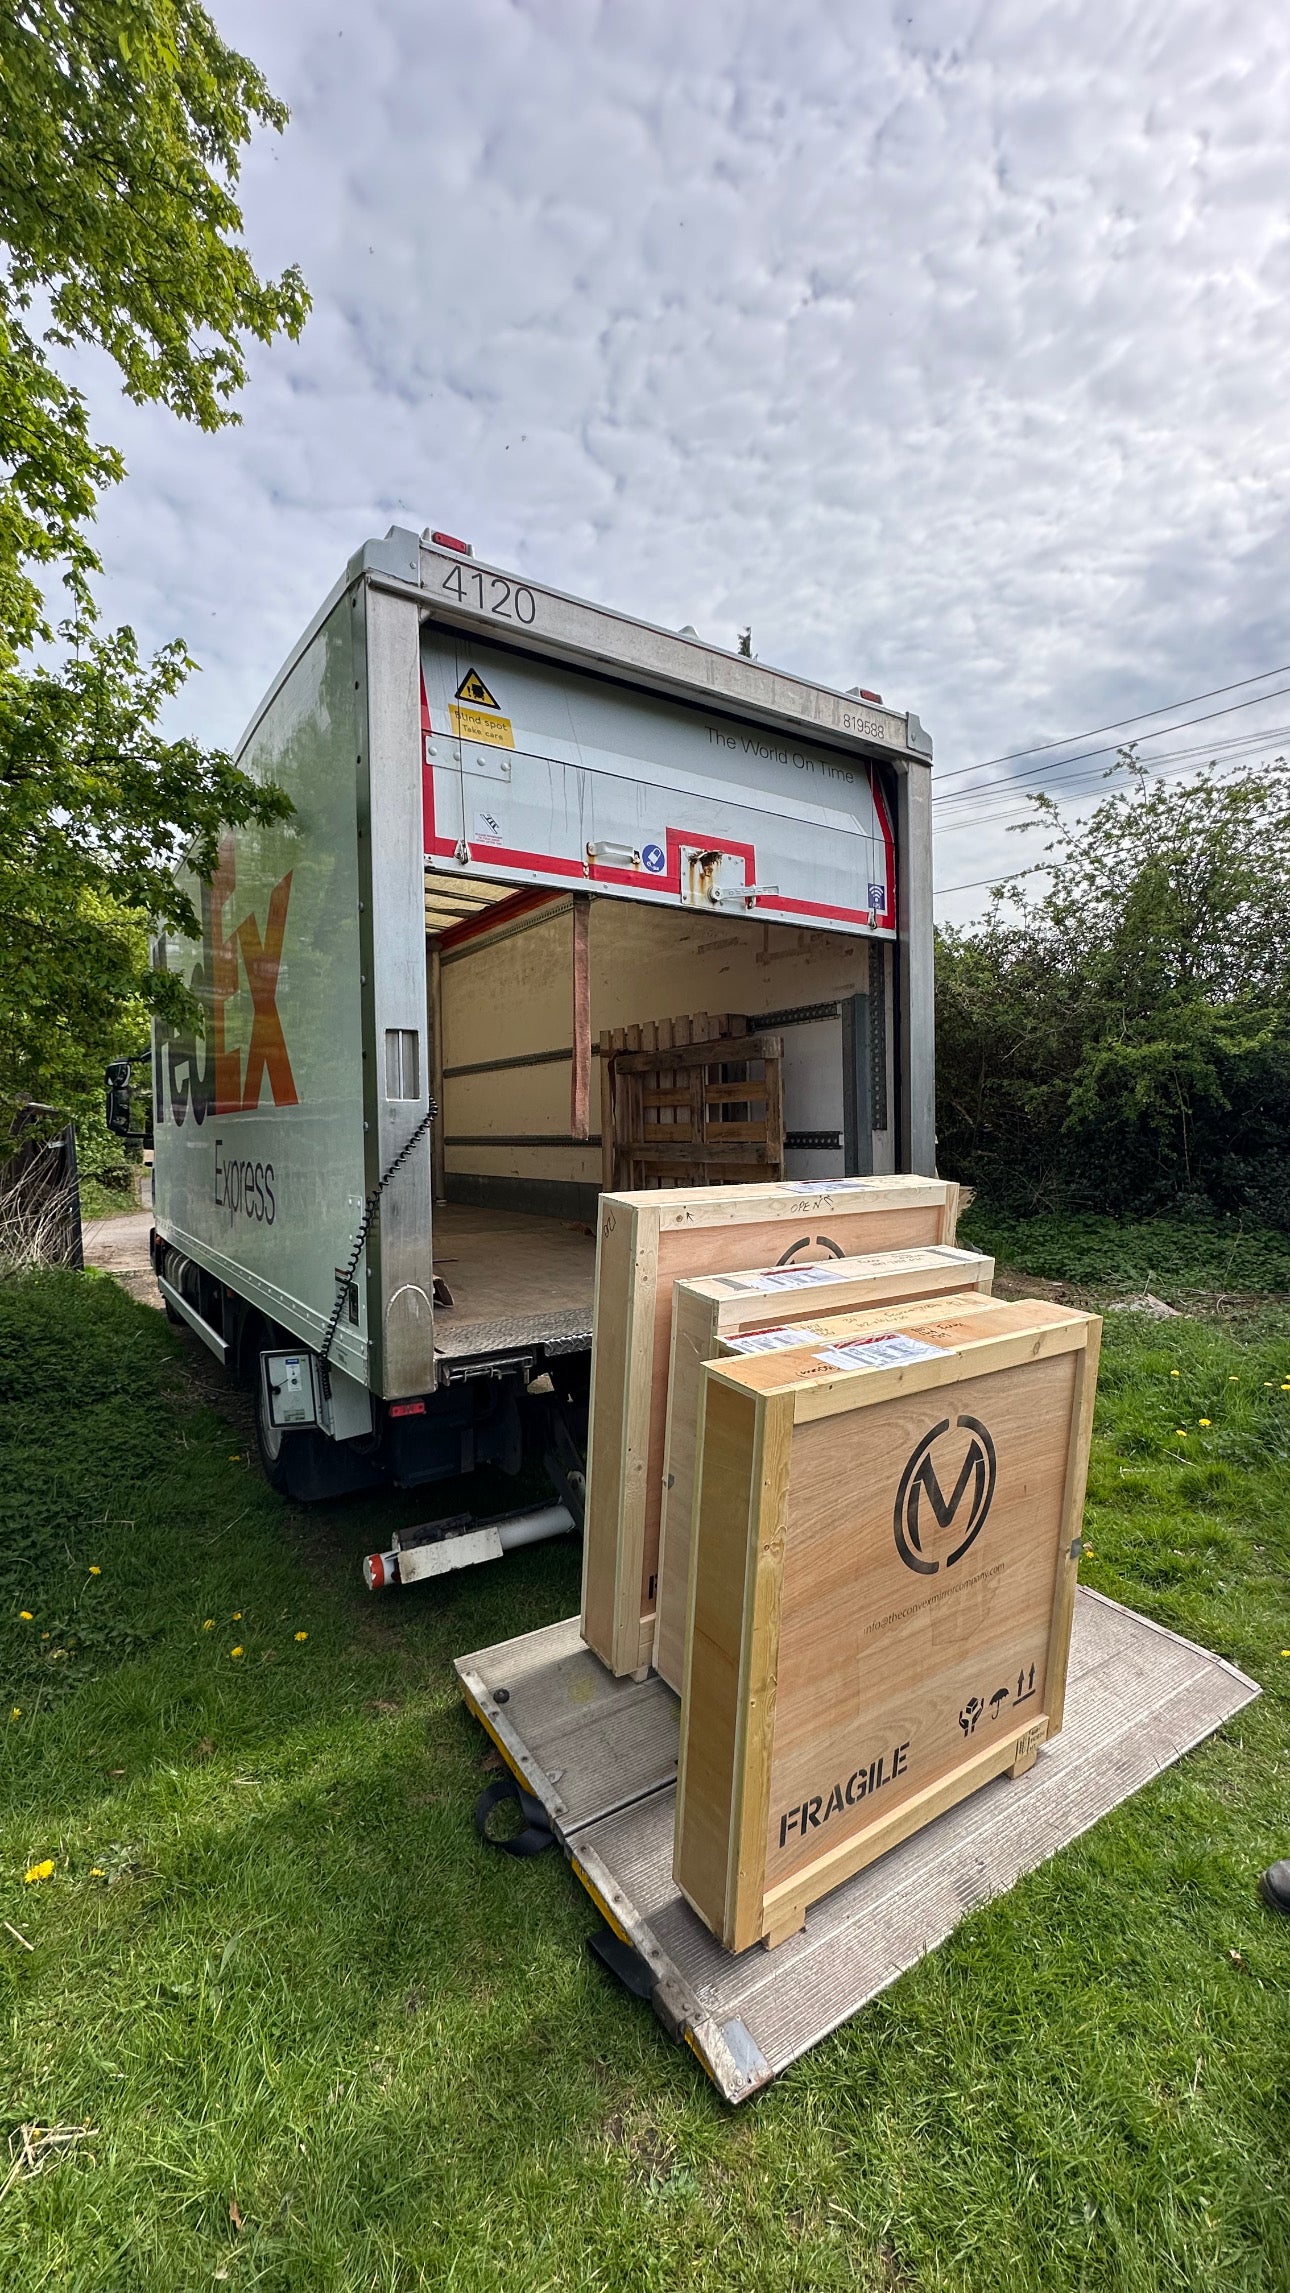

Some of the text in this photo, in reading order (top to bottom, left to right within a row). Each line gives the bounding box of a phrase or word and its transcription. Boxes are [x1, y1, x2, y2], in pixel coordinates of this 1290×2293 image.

[442, 564, 536, 624] 4120
[455, 710, 508, 732] Blind spot
[462, 724, 504, 741] Take care
[843, 713, 885, 739] 819588
[704, 726, 855, 785] The World On Time
[215, 1139, 275, 1228] Express
[790, 1196, 823, 1213] OPEN
[863, 1561, 1006, 1636] info@theconvexmirrorcompany.com
[778, 1741, 910, 1849] FRAGILE
